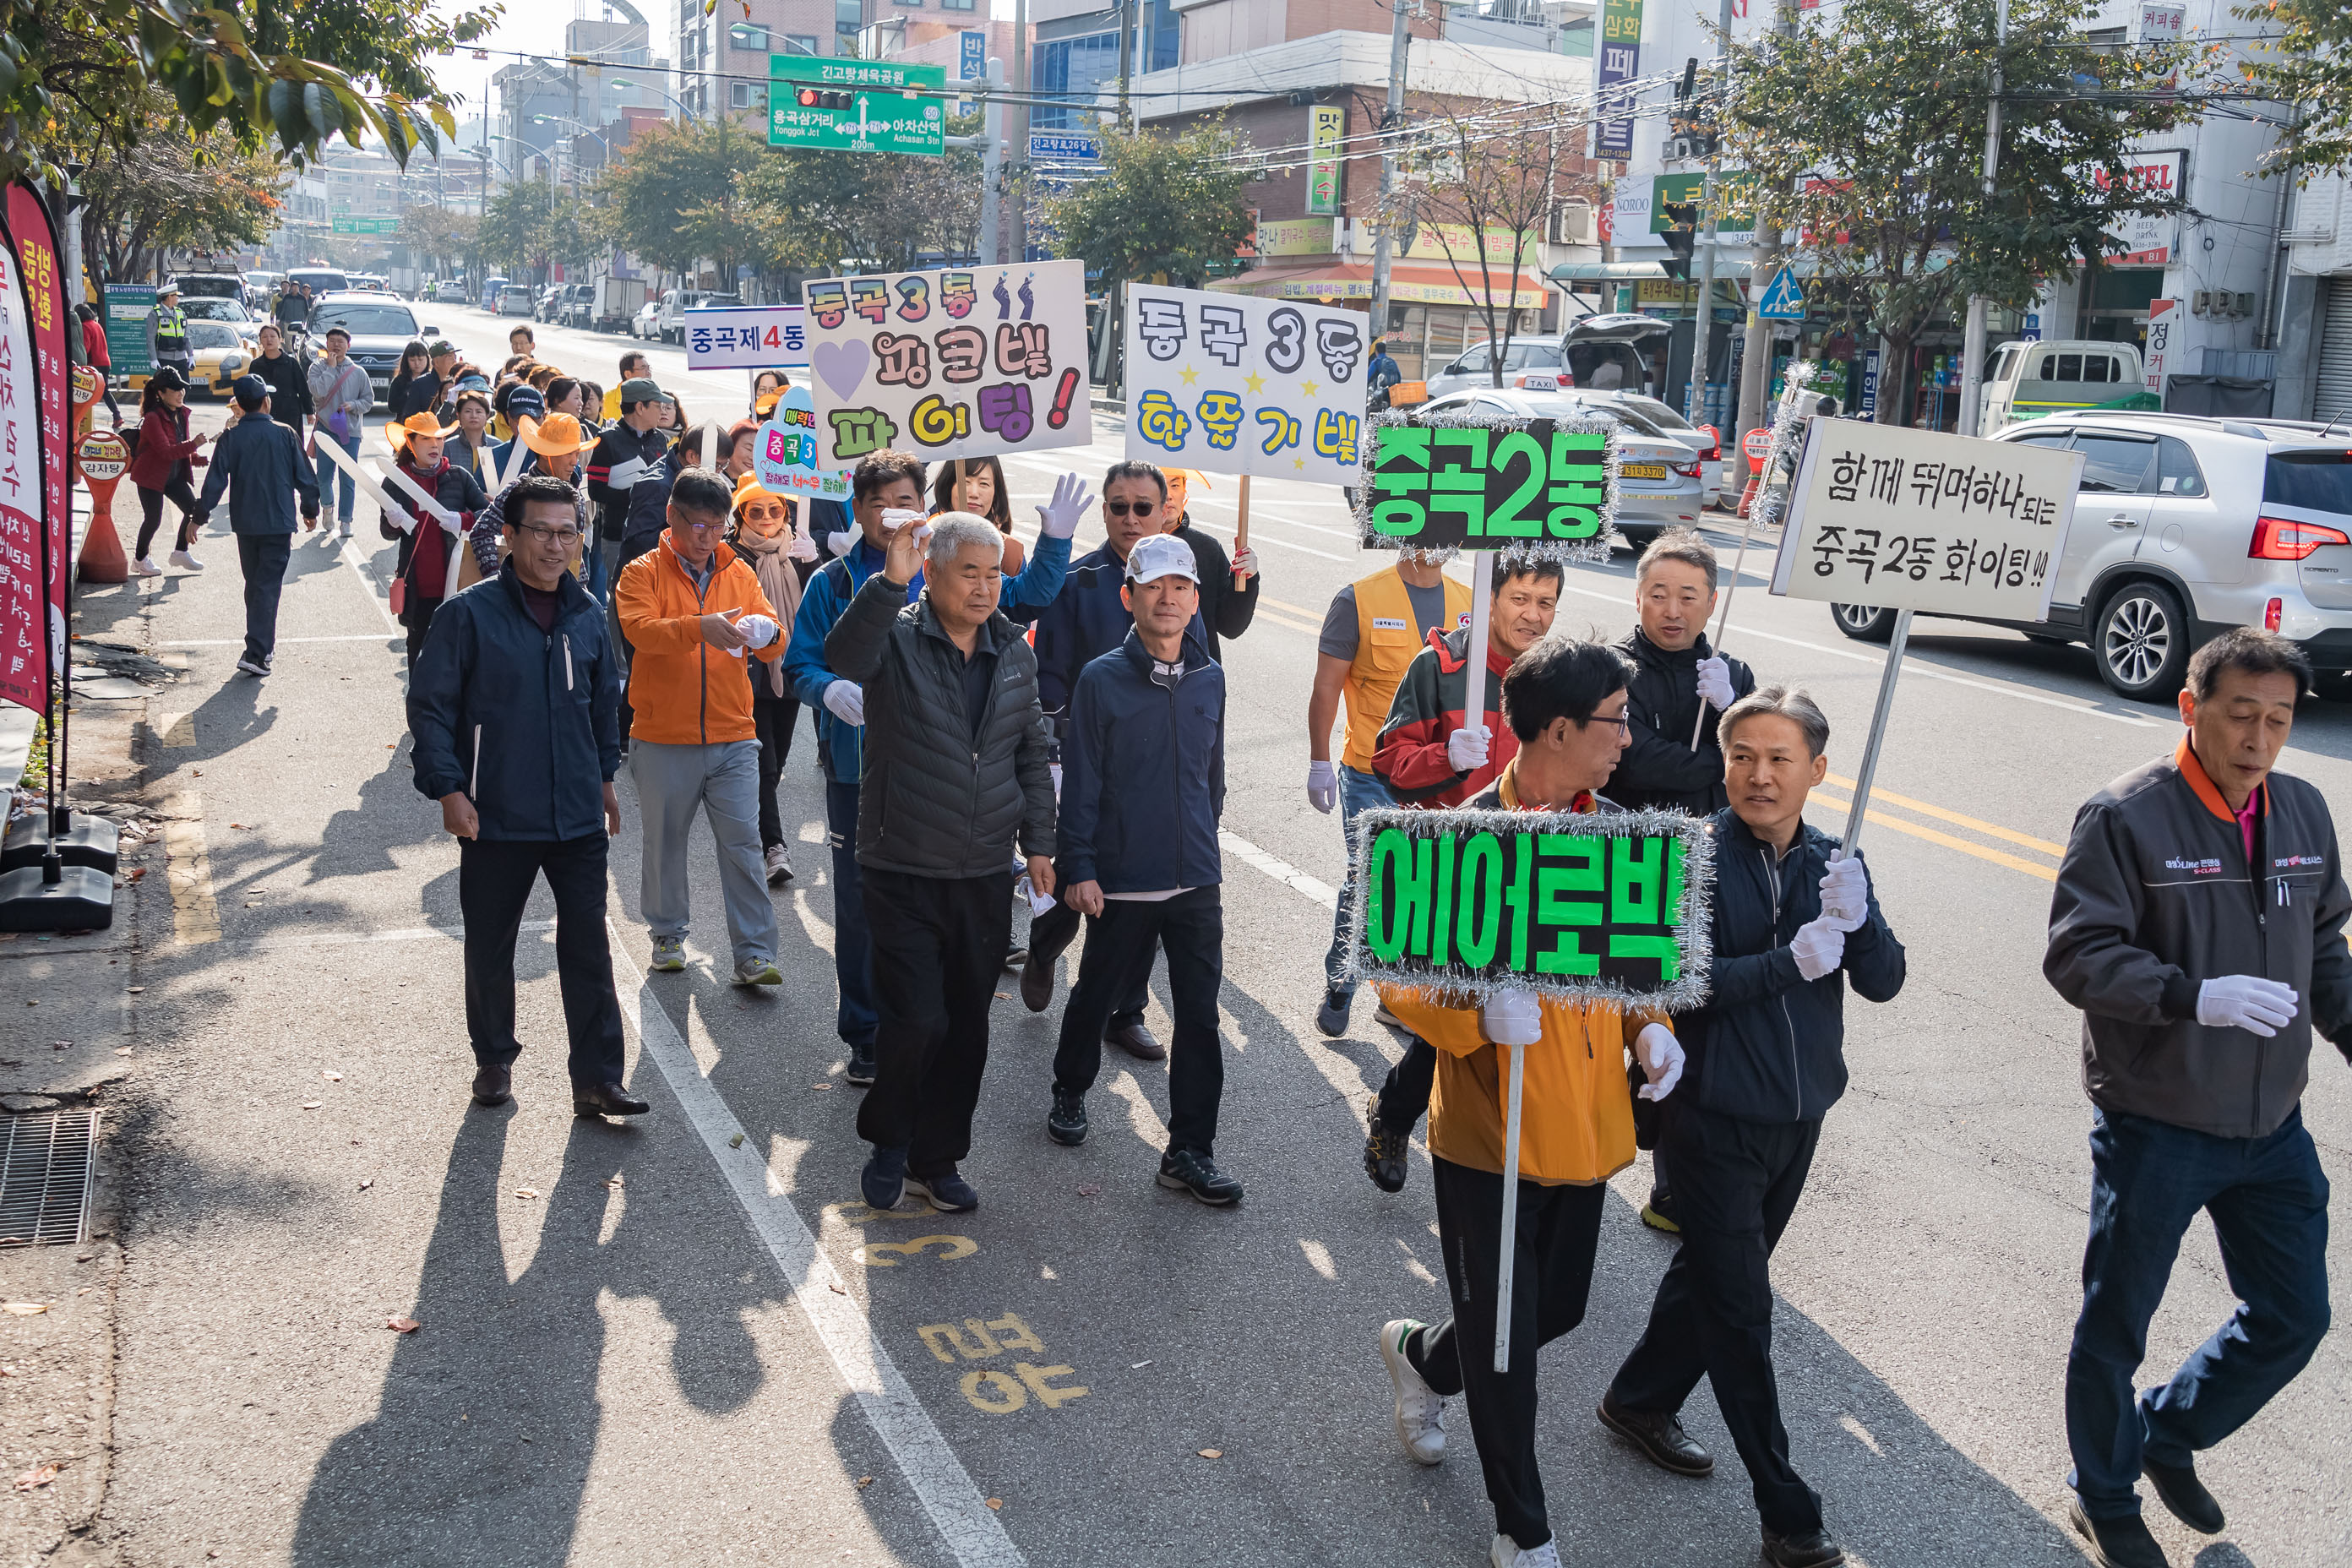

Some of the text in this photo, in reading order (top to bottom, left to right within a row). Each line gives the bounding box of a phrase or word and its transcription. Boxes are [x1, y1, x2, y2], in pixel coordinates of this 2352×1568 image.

[1604, 14, 1640, 40] 삼화
[2144, 11, 2180, 30] 커피숍
[822, 65, 904, 84] 긴고랑체육공원
[773, 110, 834, 128] 용곡삼거리
[925, 108, 935, 117] 50
[774, 126, 819, 137] Yonggok Jct
[869, 123, 880, 132] 71
[893, 118, 940, 135] 아차산역
[851, 139, 875, 150] 200m
[893, 133, 939, 144] Achasan Stn
[1596, 149, 1631, 158] 3437-1349
[1616, 198, 1649, 211] NOROO
[1259, 228, 1277, 253] 맛나
[2148, 253, 2159, 261] B1
[1348, 284, 1372, 295] 멸치국
[808, 272, 977, 330] 중곡3동
[691, 325, 804, 354] 중곡제4동
[1139, 298, 1362, 383] 중곡3동
[872, 322, 1053, 389] 핑크빛
[1863, 356, 1877, 408] 페인트
[74, 390, 89, 400] 자탕
[84, 463, 120, 473] 감자탕
[822, 476, 847, 493] 잘해!
[1372, 427, 1605, 538] 중곡2동
[1828, 450, 1904, 505] 함께
[1812, 525, 1937, 584] 중곡2동
[1368, 828, 1690, 980] 에어로빅
